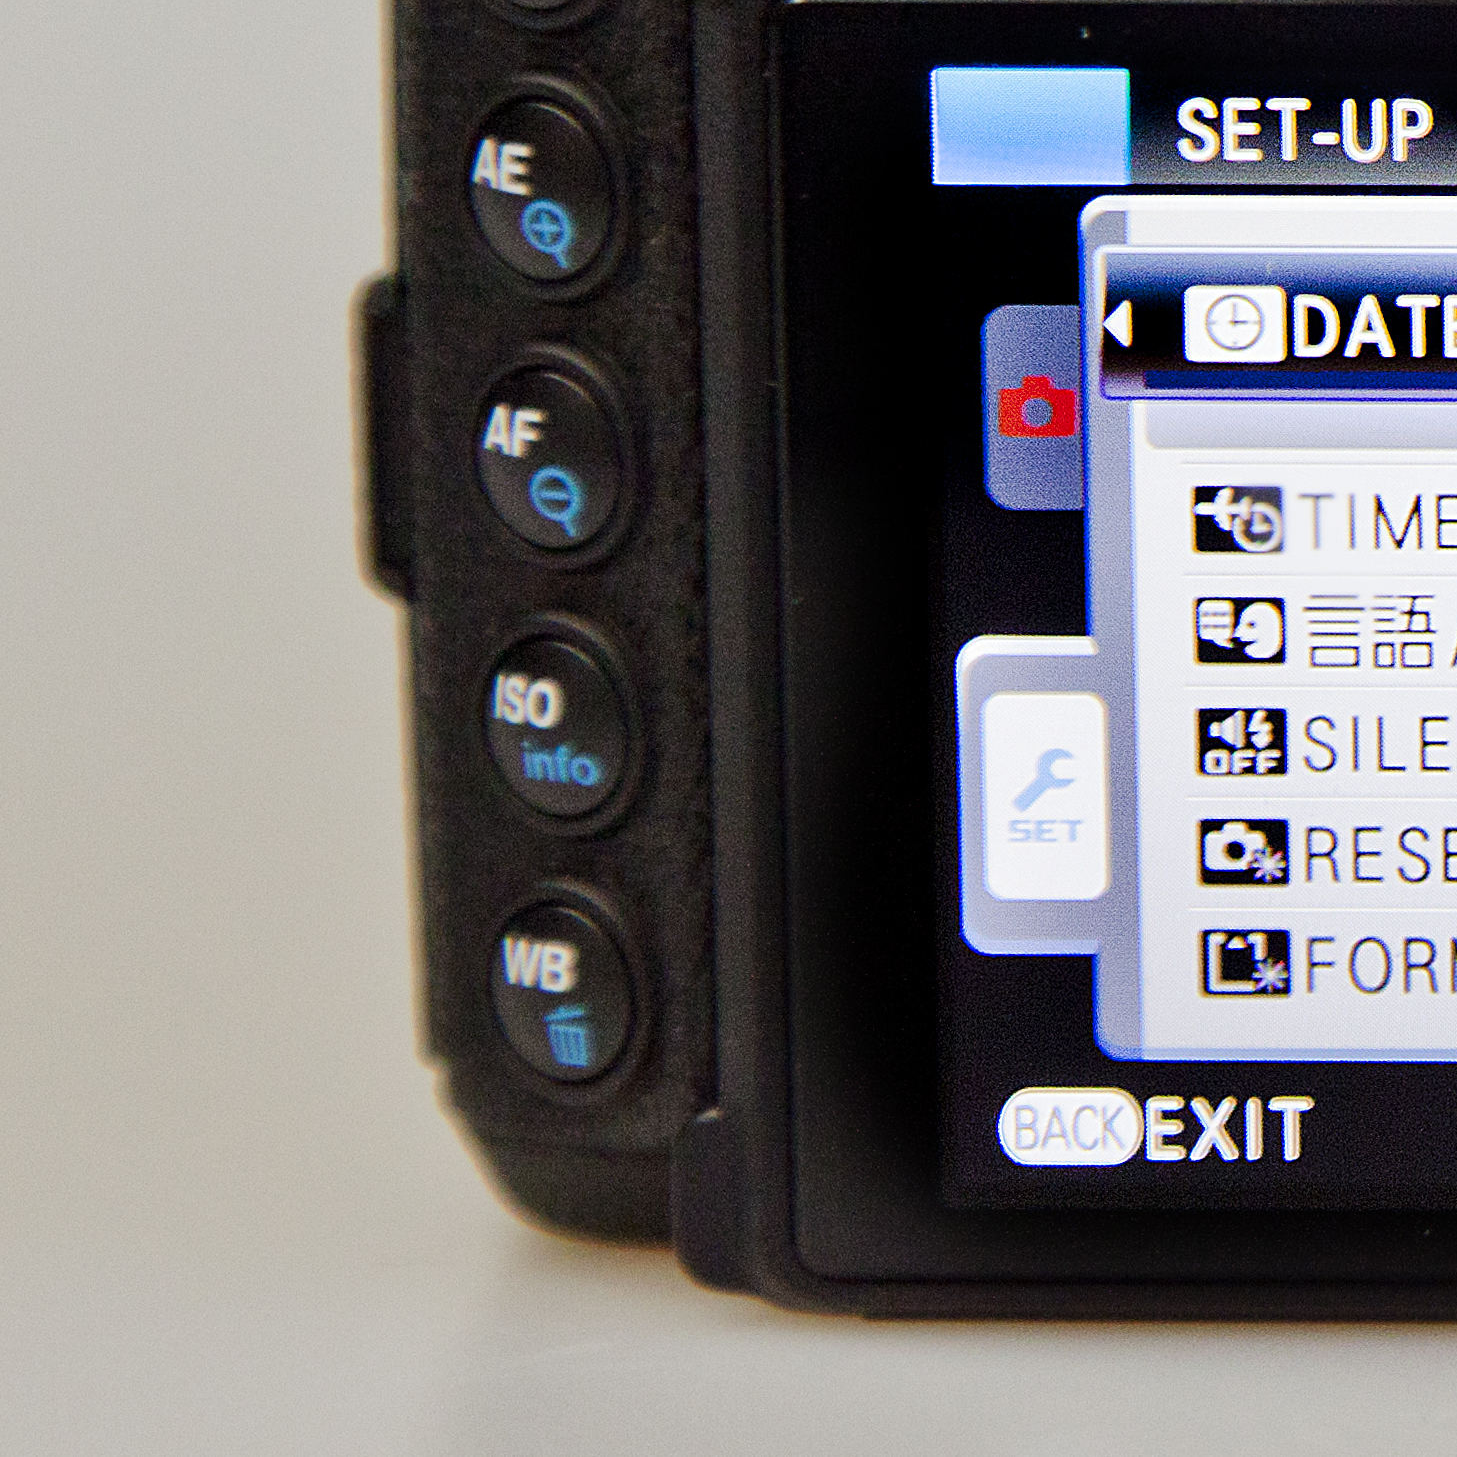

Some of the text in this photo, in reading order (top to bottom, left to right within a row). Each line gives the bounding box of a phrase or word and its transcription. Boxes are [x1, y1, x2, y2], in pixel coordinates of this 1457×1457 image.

[1175, 96, 1434, 163] SET-UP
[471, 137, 534, 196] AE
[482, 404, 547, 458] AF
[492, 674, 563, 729] ISO
[521, 743, 600, 787] info
[1203, 749, 1282, 774] OFF
[1006, 817, 1084, 844] SET
[502, 935, 577, 993] WB
[1014, 1105, 1126, 1151] BACK
[1144, 1096, 1314, 1162] EXIT
